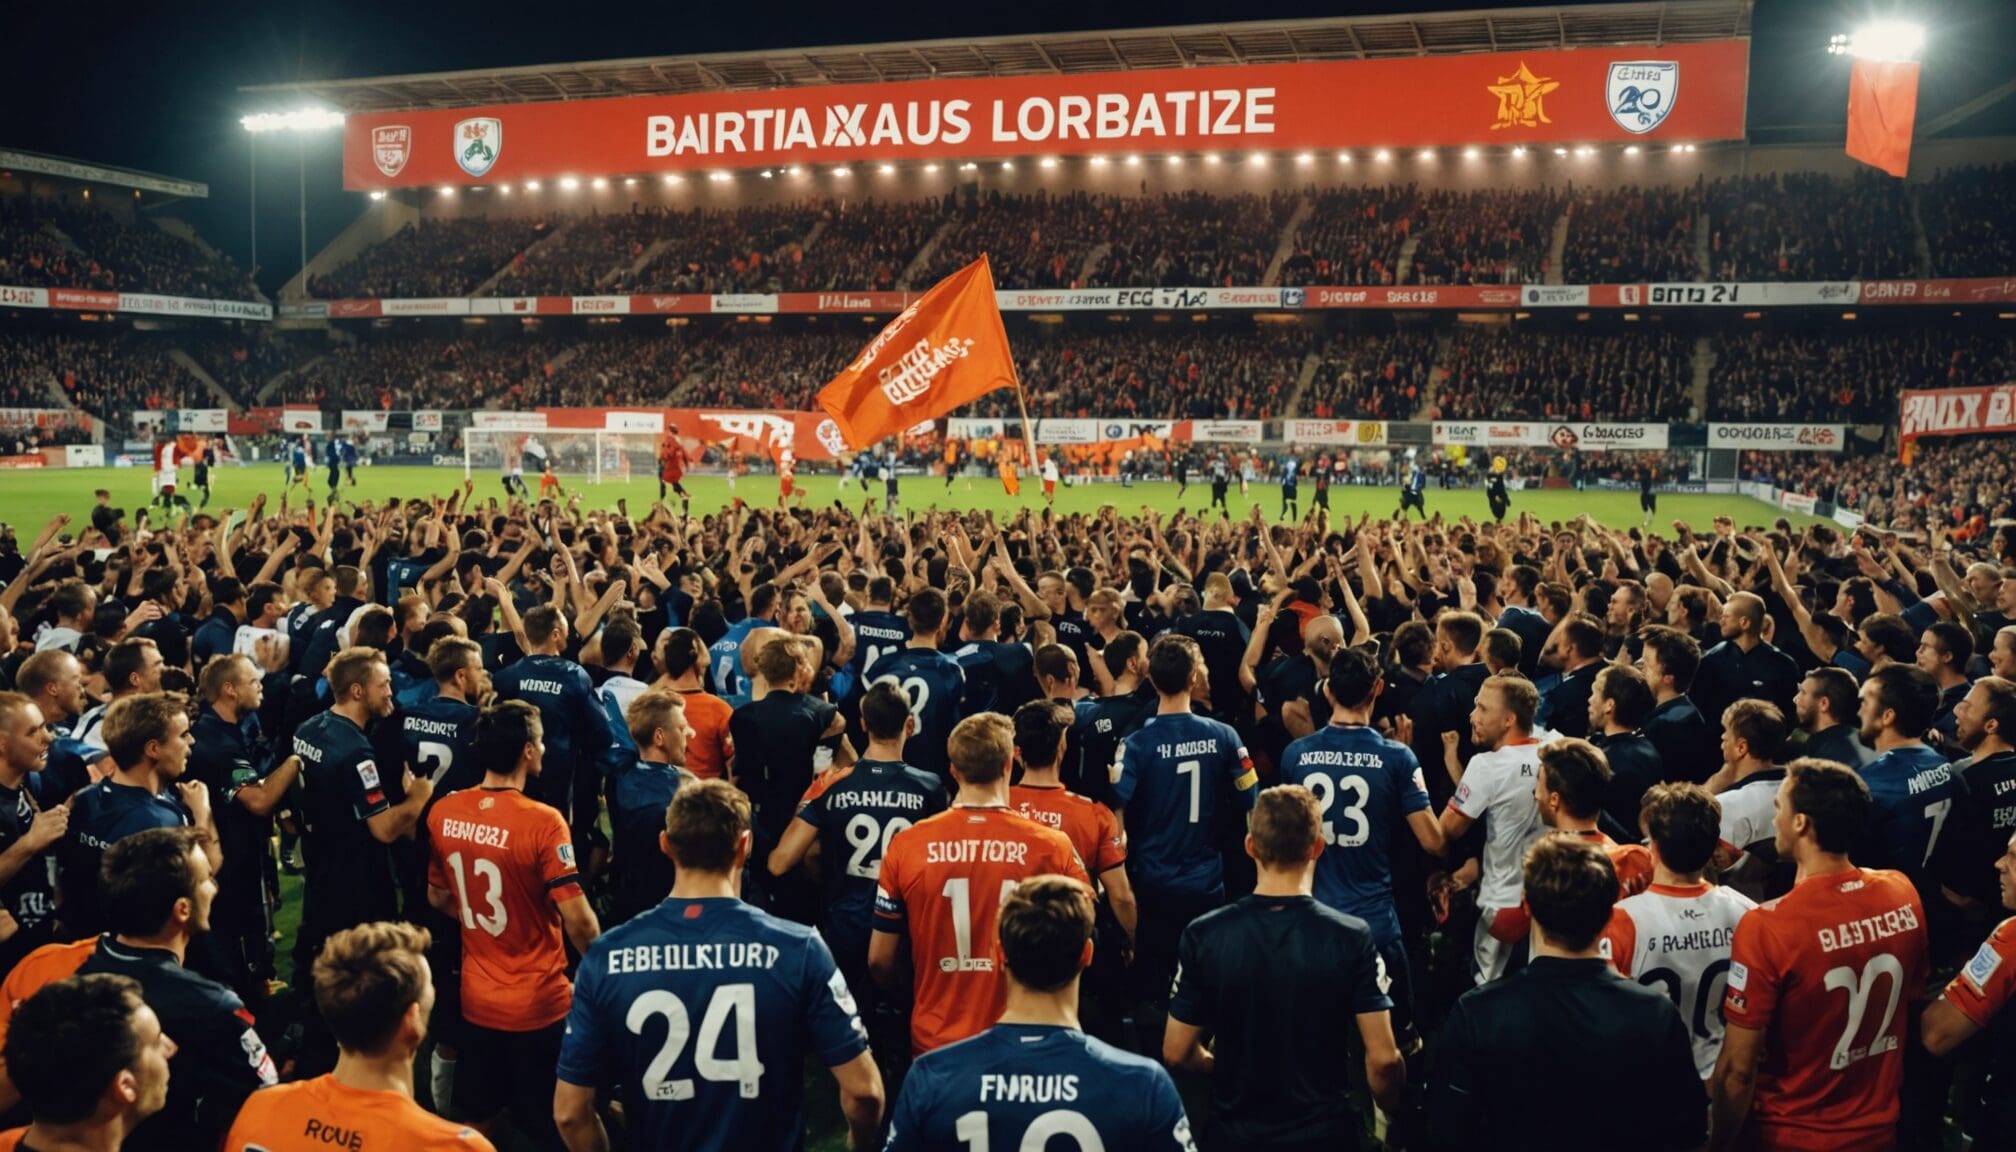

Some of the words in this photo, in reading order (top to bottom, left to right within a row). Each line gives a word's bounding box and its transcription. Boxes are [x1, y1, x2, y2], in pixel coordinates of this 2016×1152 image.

[992, 87, 1276, 142] LORBATIZE
[1303, 772, 1370, 848] 23
[447, 851, 509, 938] 13
[625, 983, 765, 1101] 24
